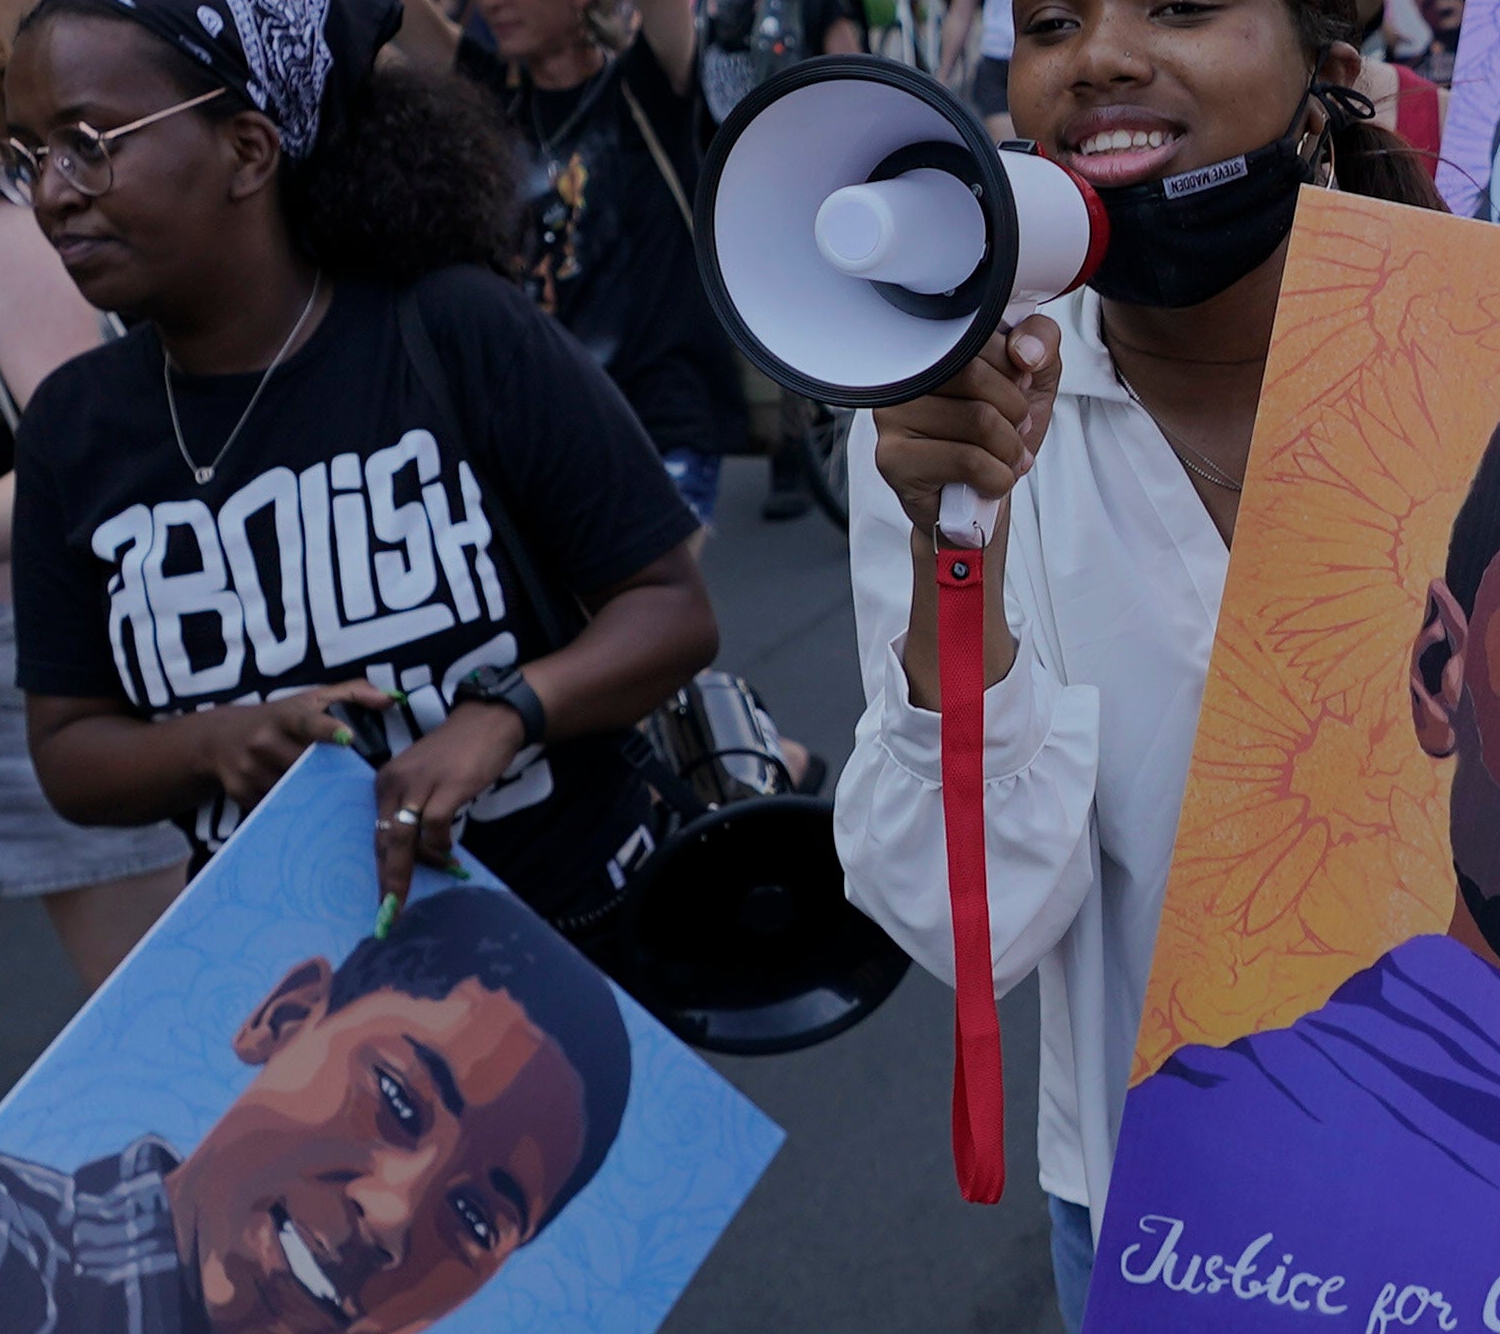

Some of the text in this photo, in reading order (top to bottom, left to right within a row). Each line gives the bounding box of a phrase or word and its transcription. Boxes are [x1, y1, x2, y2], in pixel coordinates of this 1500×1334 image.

[1170, 160, 1242, 194] STEVE MADDEN
[1119, 1213, 1350, 1316] Justice
